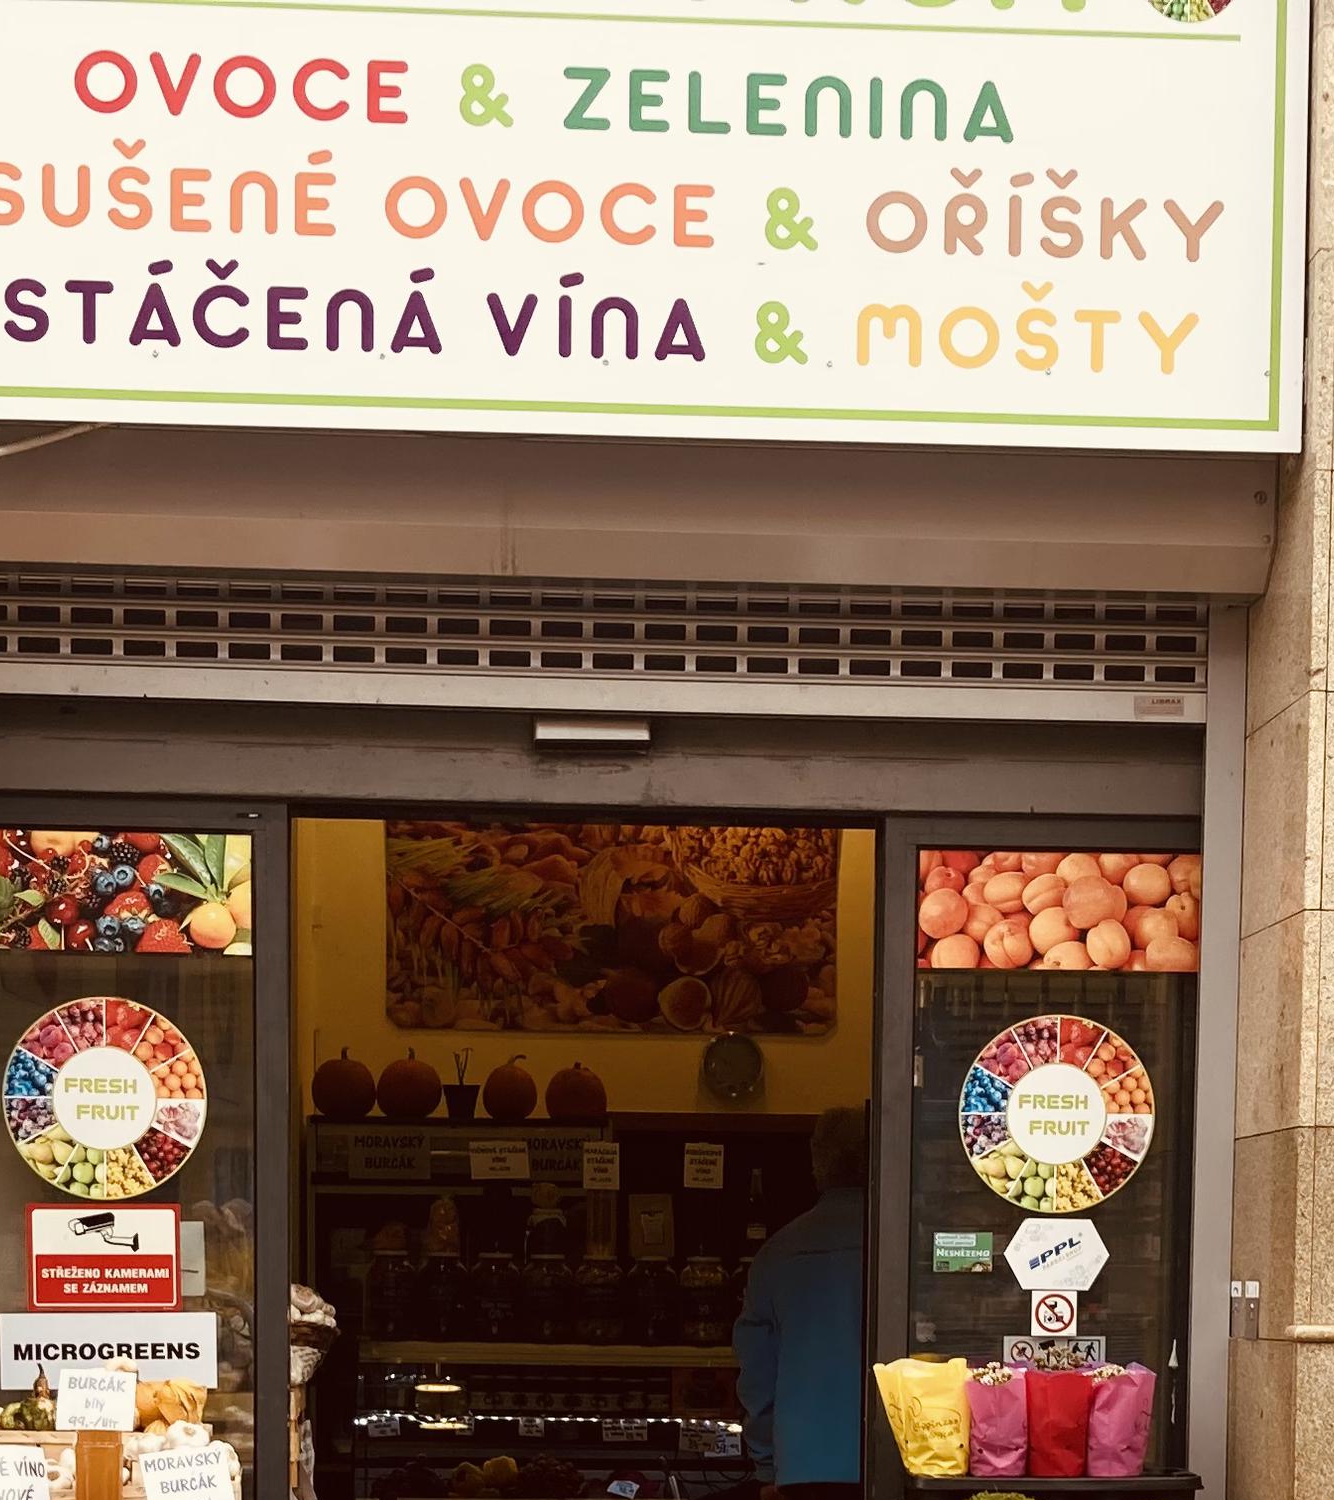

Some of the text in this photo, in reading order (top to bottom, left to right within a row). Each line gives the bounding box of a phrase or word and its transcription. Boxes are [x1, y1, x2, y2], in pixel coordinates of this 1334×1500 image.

[74, 49, 1014, 143] OVOCE & ZELENINA
[384, 175, 715, 249] OVOCE
[765, 187, 819, 252] &
[866, 167, 1225, 262] OŘÍŠKY
[3, 257, 1200, 375] STÁČENÁ VÍNA & MOŠTY
[64, 1078, 138, 1095] FRESH
[1018, 1094, 1089, 1111] FRESH
[76, 1104, 140, 1121] FRUIT
[1029, 1120, 1090, 1136] FRUIT
[1040, 1237, 1082, 1264] PPL
[41, 1266, 170, 1279] STŘEŽENO KAMERAMI
[63, 1280, 149, 1294] SE ZÁZNAMEM
[13, 1342, 201, 1361] MICROGREENS
[13, 1456, 46, 1478] VÍNO
